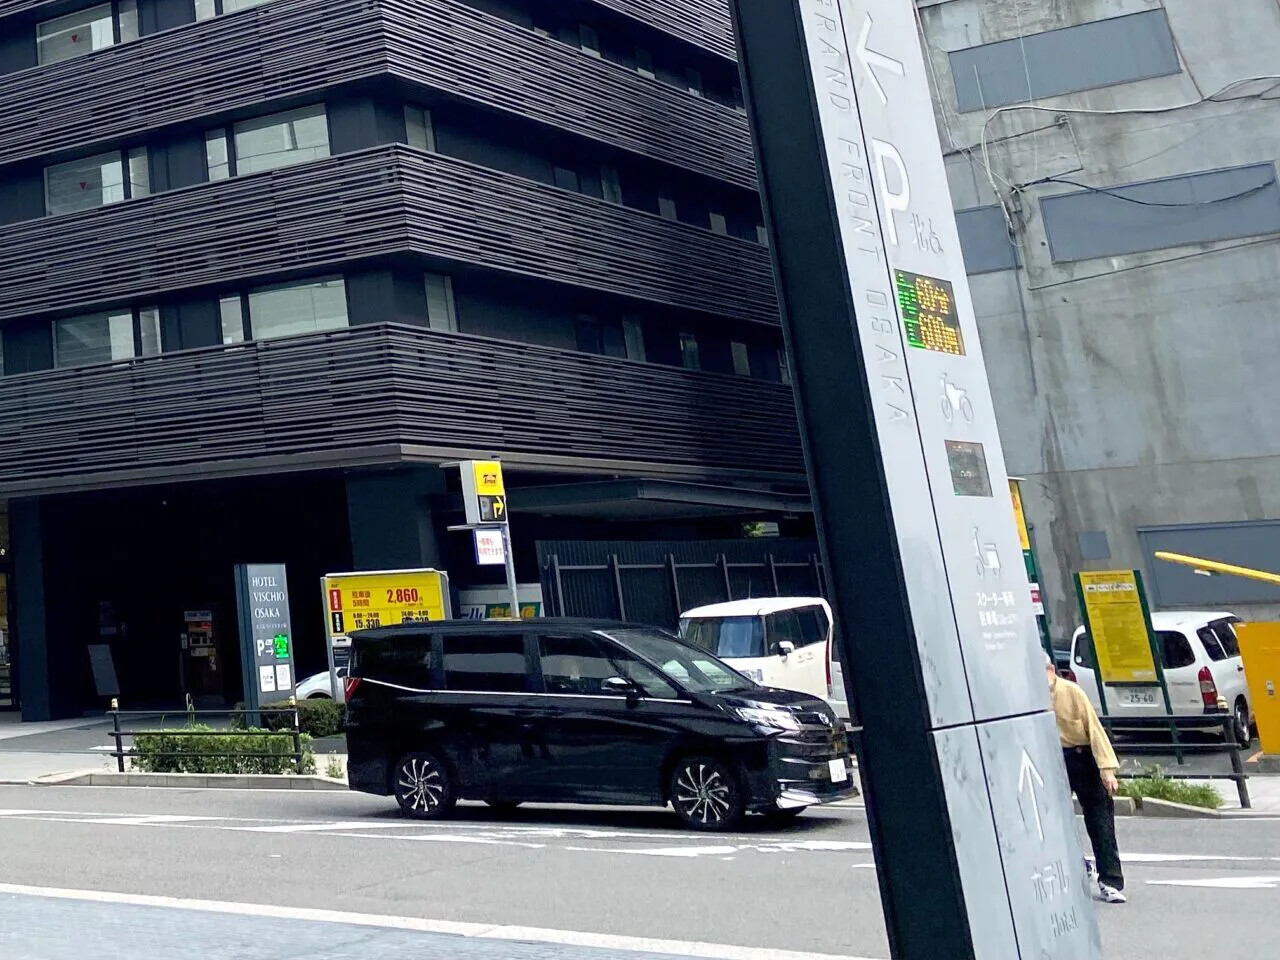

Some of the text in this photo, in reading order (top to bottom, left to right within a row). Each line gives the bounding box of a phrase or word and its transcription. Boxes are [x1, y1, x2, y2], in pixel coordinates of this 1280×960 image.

[872, 136, 911, 246] P
[837, 136, 881, 262] FRONT
[866, 289, 910, 423] OSAKA
[252, 576, 277, 587] HOTEL
[253, 591, 285, 602] VISCHIO
[254, 607, 280, 618] OSAKA
[256, 639, 265, 657] P
[1030, 859, 1070, 905] ホテル
